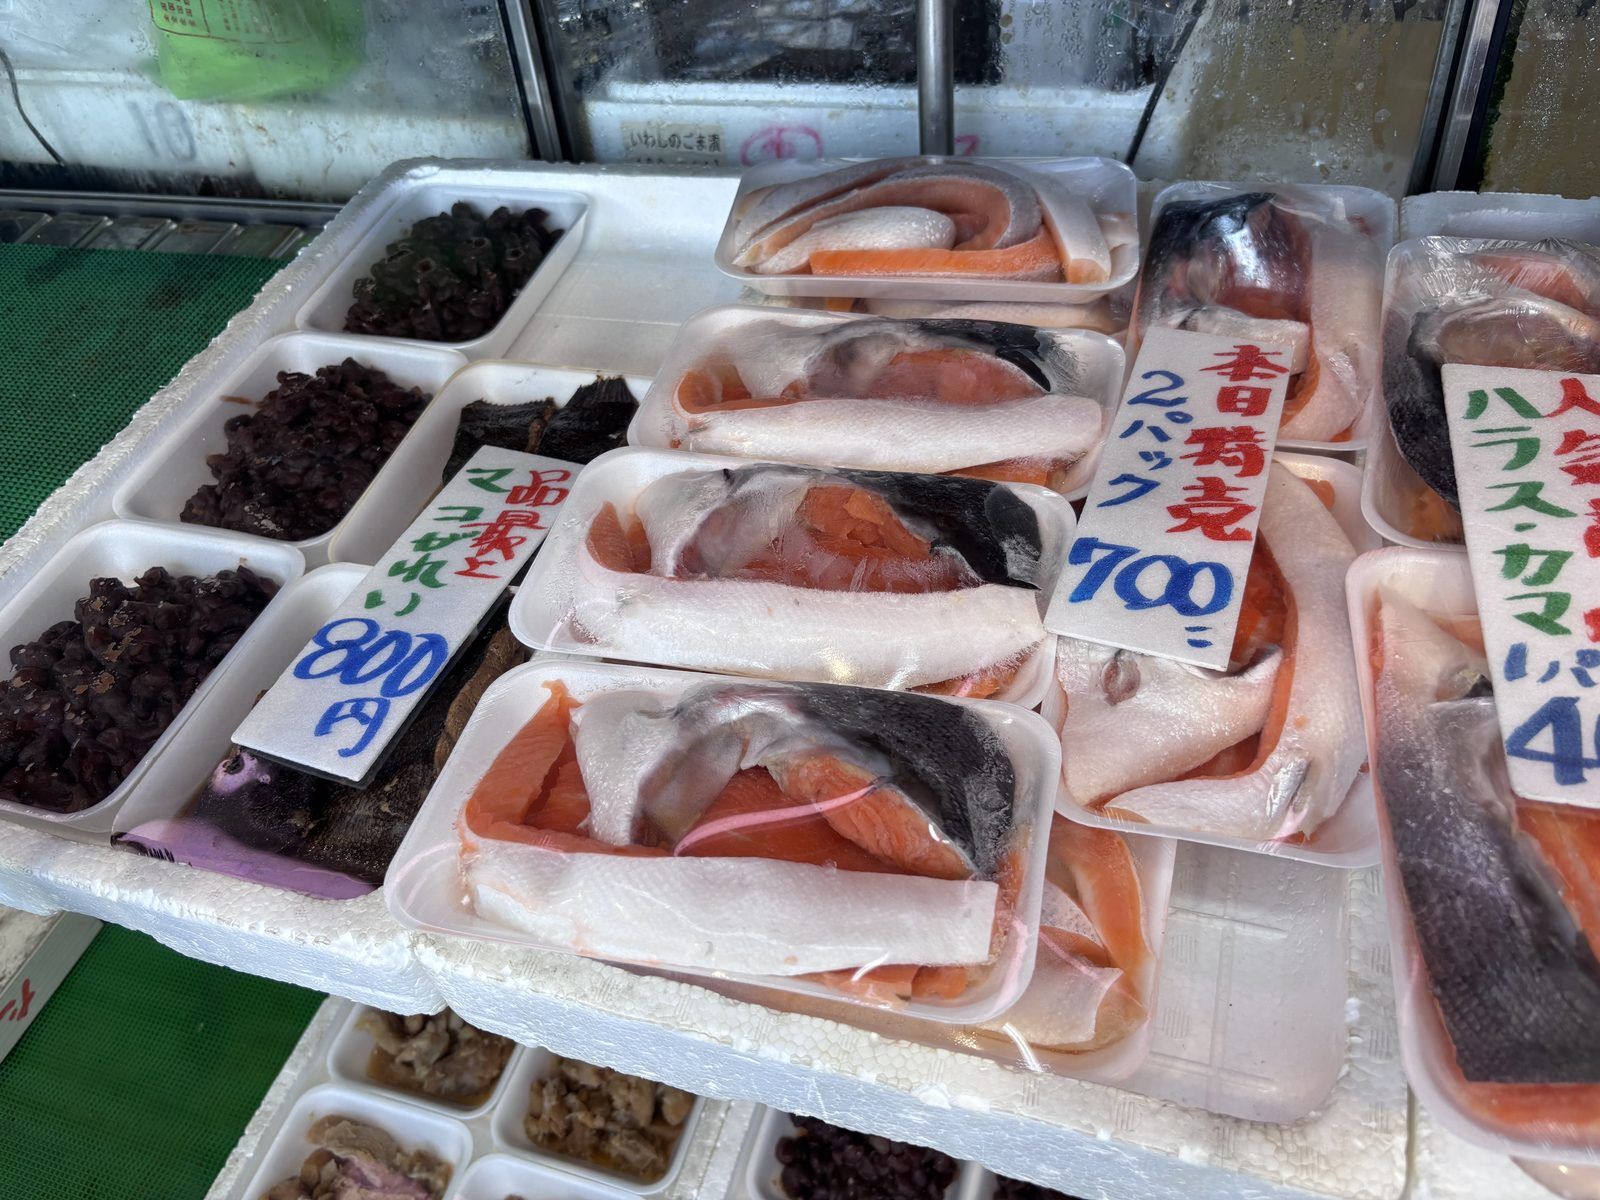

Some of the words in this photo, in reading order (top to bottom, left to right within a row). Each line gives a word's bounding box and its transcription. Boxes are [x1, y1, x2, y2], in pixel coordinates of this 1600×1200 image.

[1097, 370, 1194, 508] 2パック
[1068, 537, 1234, 617] 700
[1505, 697, 1600, 785] 4
